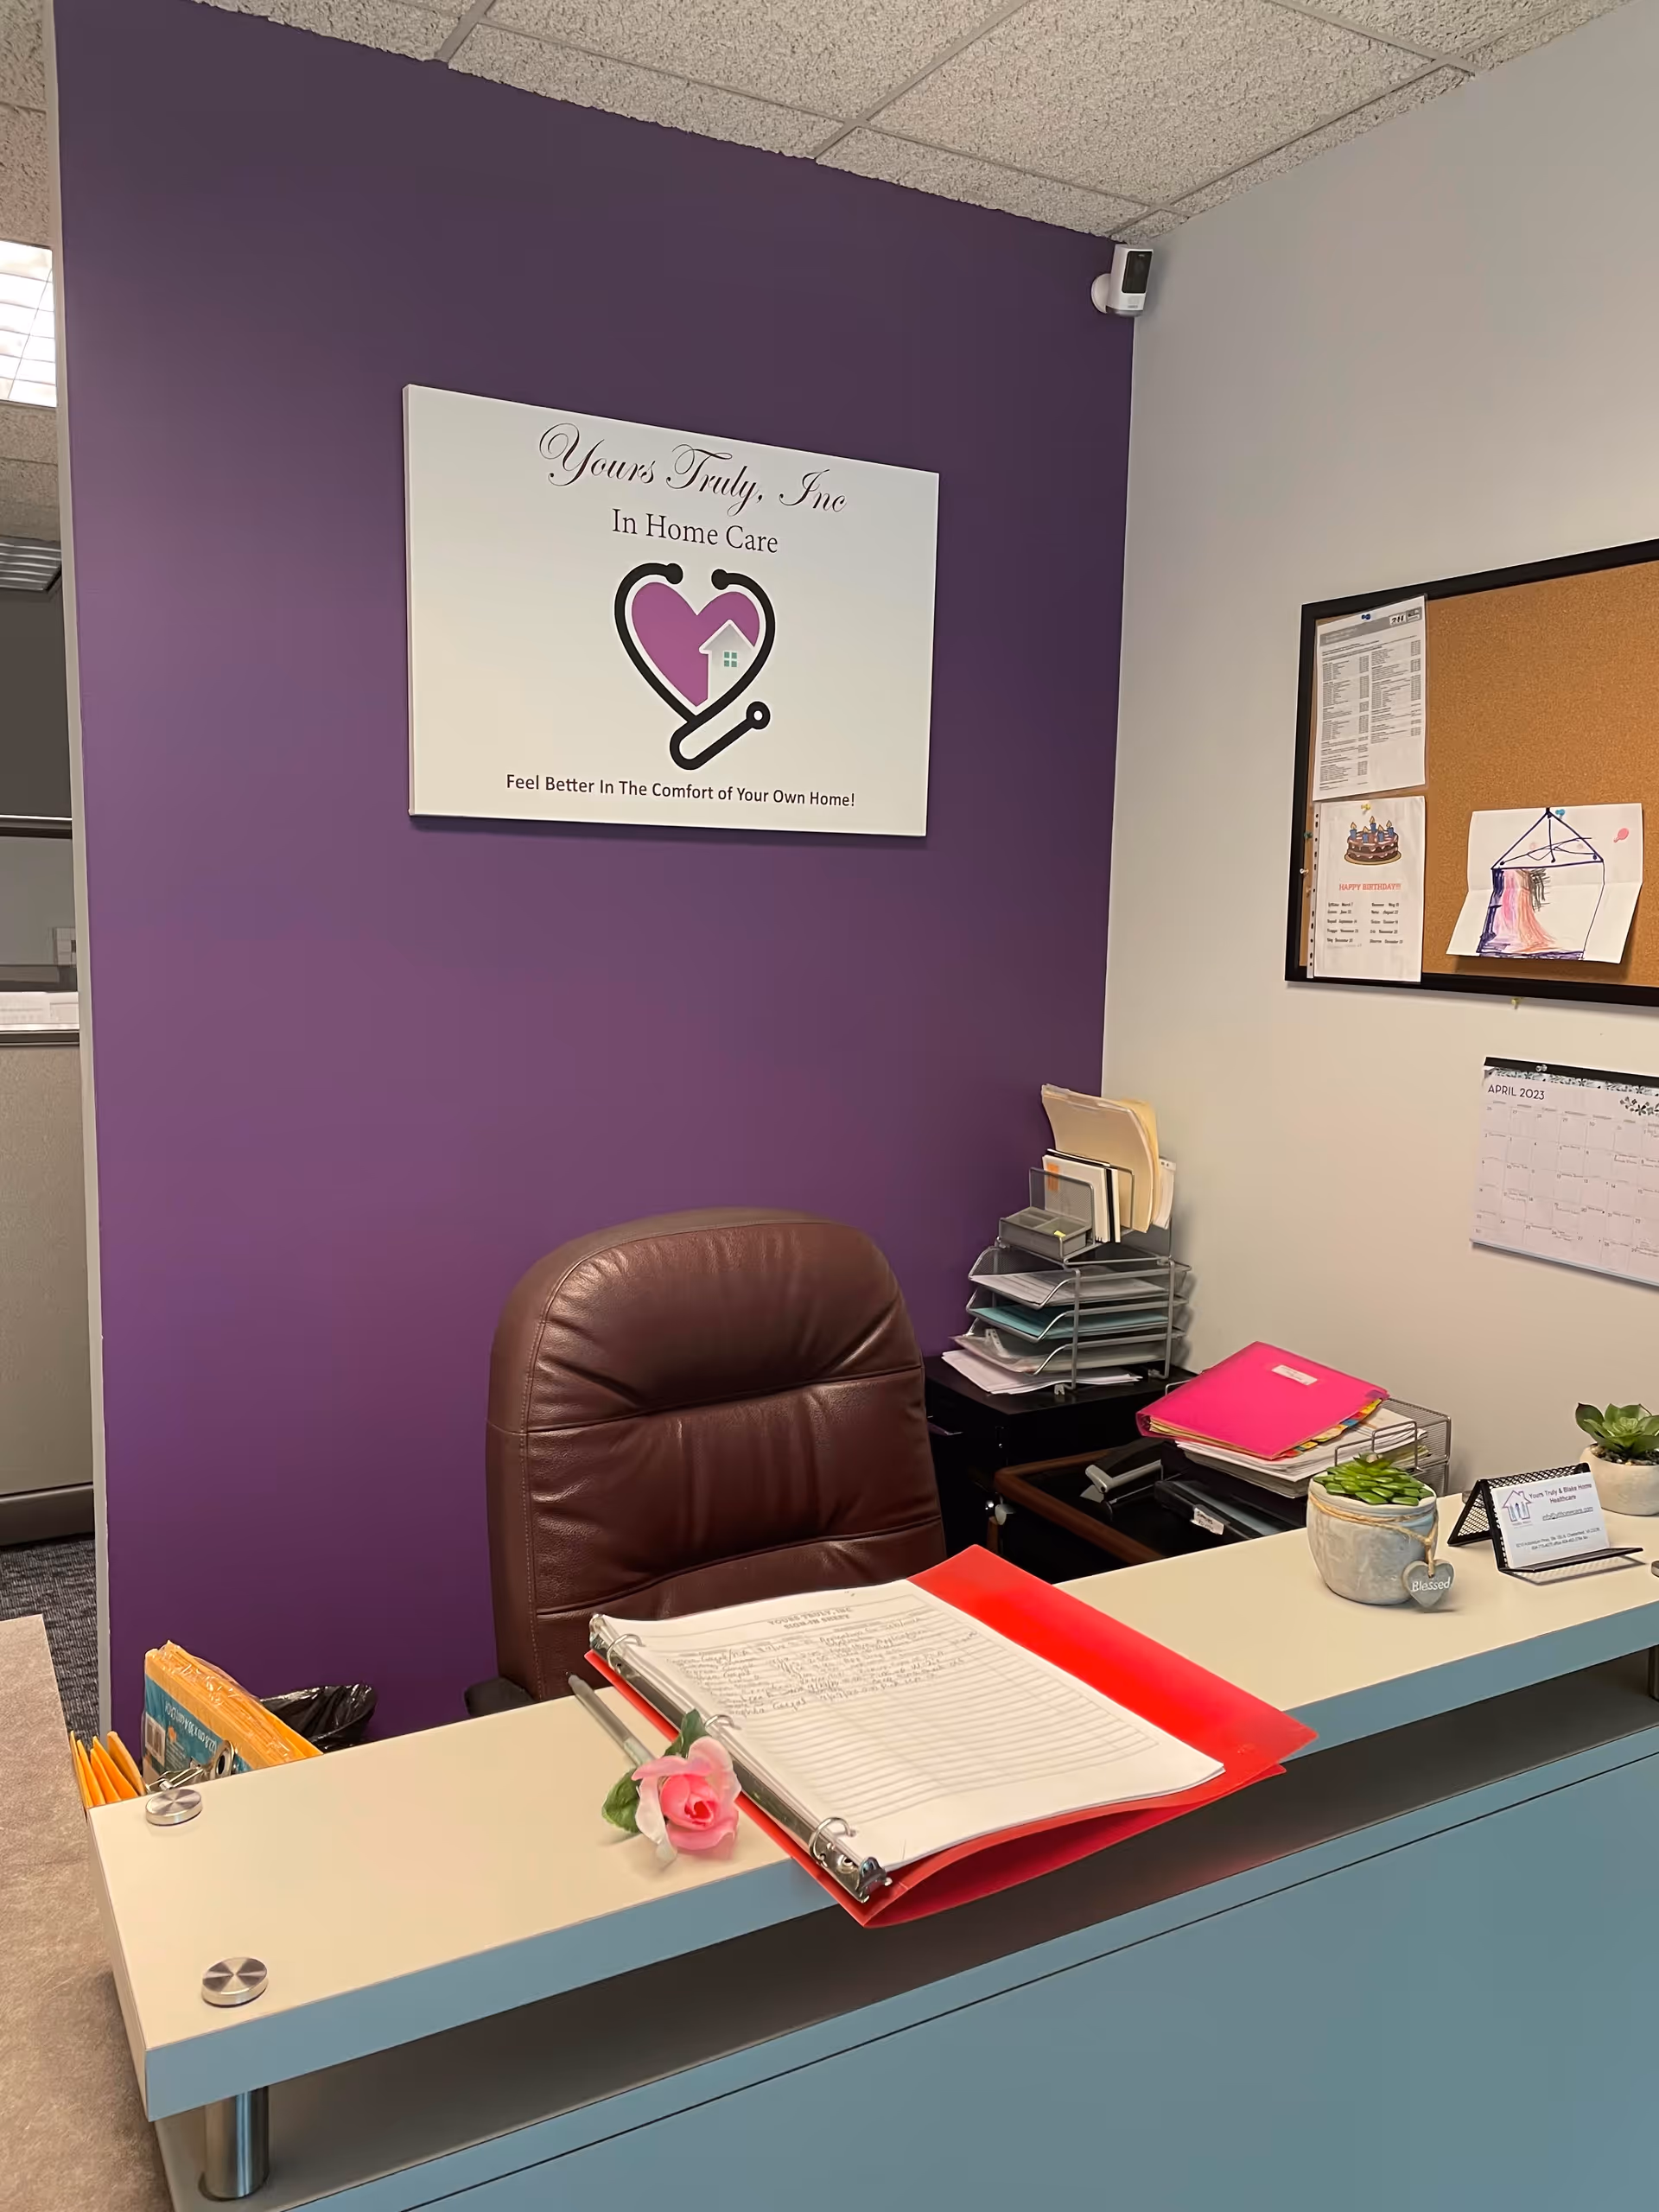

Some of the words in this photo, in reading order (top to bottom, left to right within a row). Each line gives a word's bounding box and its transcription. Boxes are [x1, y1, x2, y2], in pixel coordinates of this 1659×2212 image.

[539, 423, 656, 486] Yours
[665, 443, 764, 518] Truly,
[779, 468, 848, 512] Inc
[612, 508, 638, 535] In
[645, 512, 718, 545] Home
[726, 524, 778, 554] Care
[506, 774, 539, 790] Feel
[545, 776, 595, 793] Better
[600, 779, 613, 794] In
[619, 780, 647, 796] The
[652, 782, 714, 799] Comfort
[718, 786, 733, 800] of
[737, 787, 769, 802] Your
[773, 790, 805, 804] Own
[810, 791, 855, 807] Home!
[1487, 1084, 1517, 1096] APRIL
[1519, 1088, 1546, 1101] 2023
[1549, 1495, 1577, 1503] Healthcare
[1412, 1576, 1451, 1592] Blessed
[767, 1615, 801, 1625] YOURS
[801, 1610, 836, 1620] TRULY,
